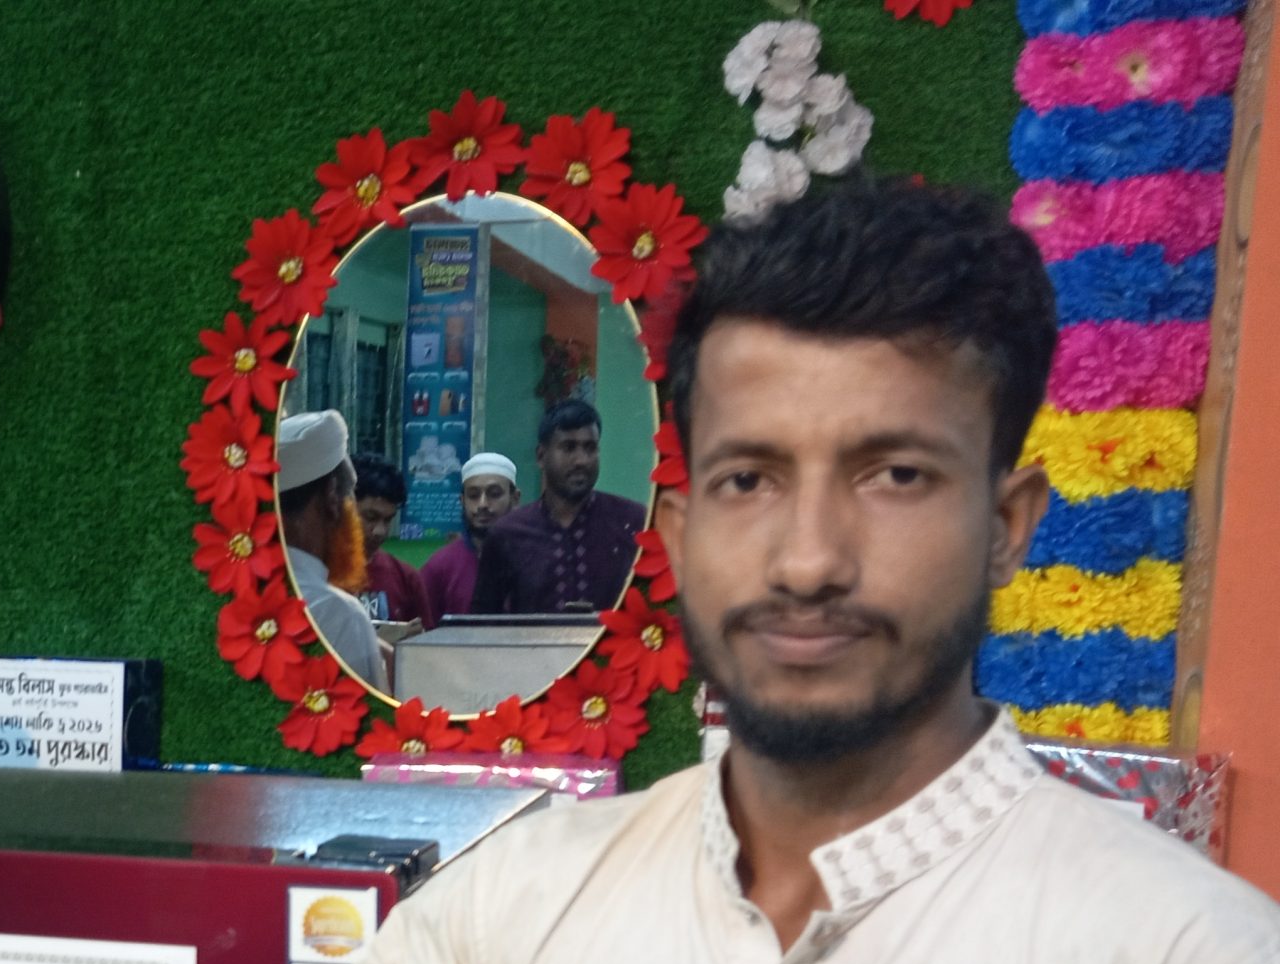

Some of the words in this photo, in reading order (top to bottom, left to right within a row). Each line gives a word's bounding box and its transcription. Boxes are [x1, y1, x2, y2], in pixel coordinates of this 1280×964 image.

[18, 672, 55, 696] বিলাস
[26, 711, 53, 731] লাকি
[46, 739, 109, 768] পুরস্কার
